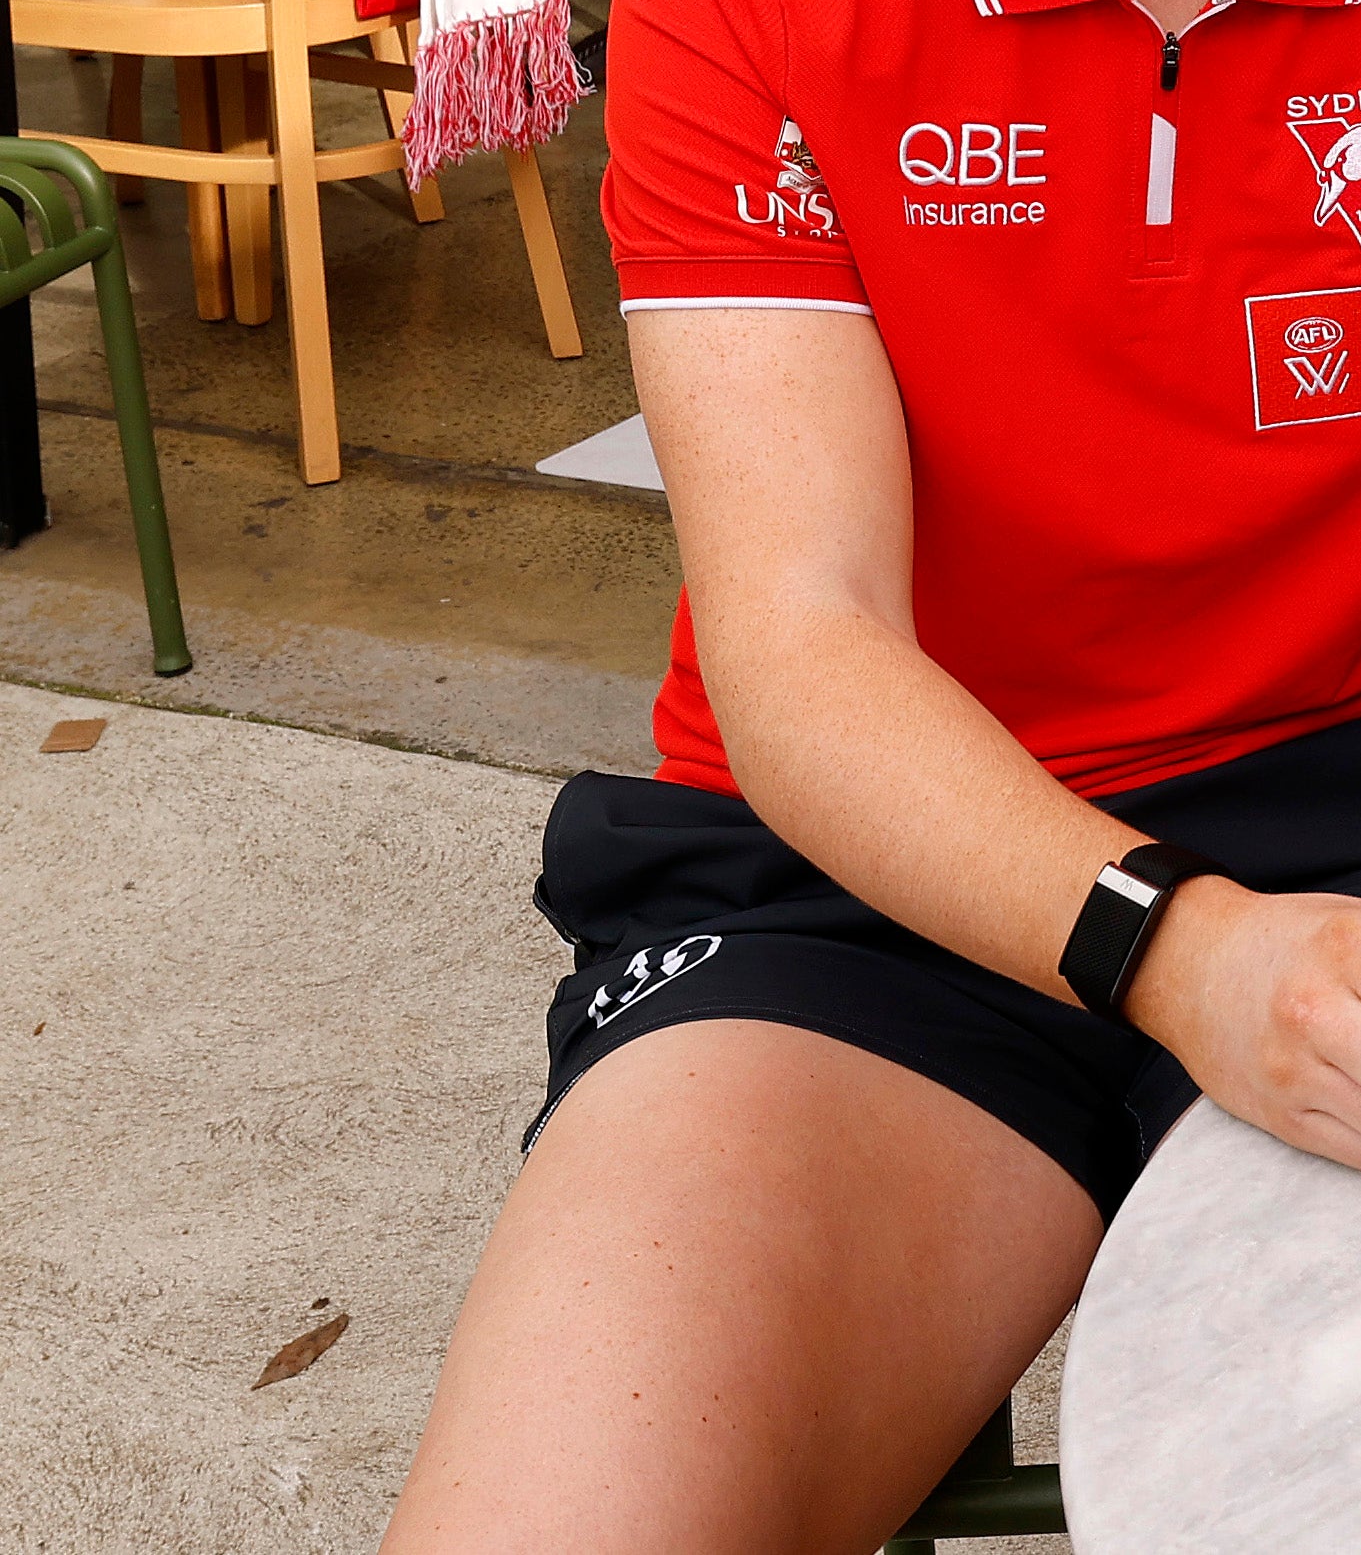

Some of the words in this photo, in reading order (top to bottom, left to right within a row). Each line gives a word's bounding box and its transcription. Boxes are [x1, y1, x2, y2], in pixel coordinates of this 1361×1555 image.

[899, 123, 1047, 186] QBE
[735, 184, 834, 231] UNS
[903, 195, 1046, 226] Insurance
[1291, 328, 1336, 345] AFL
